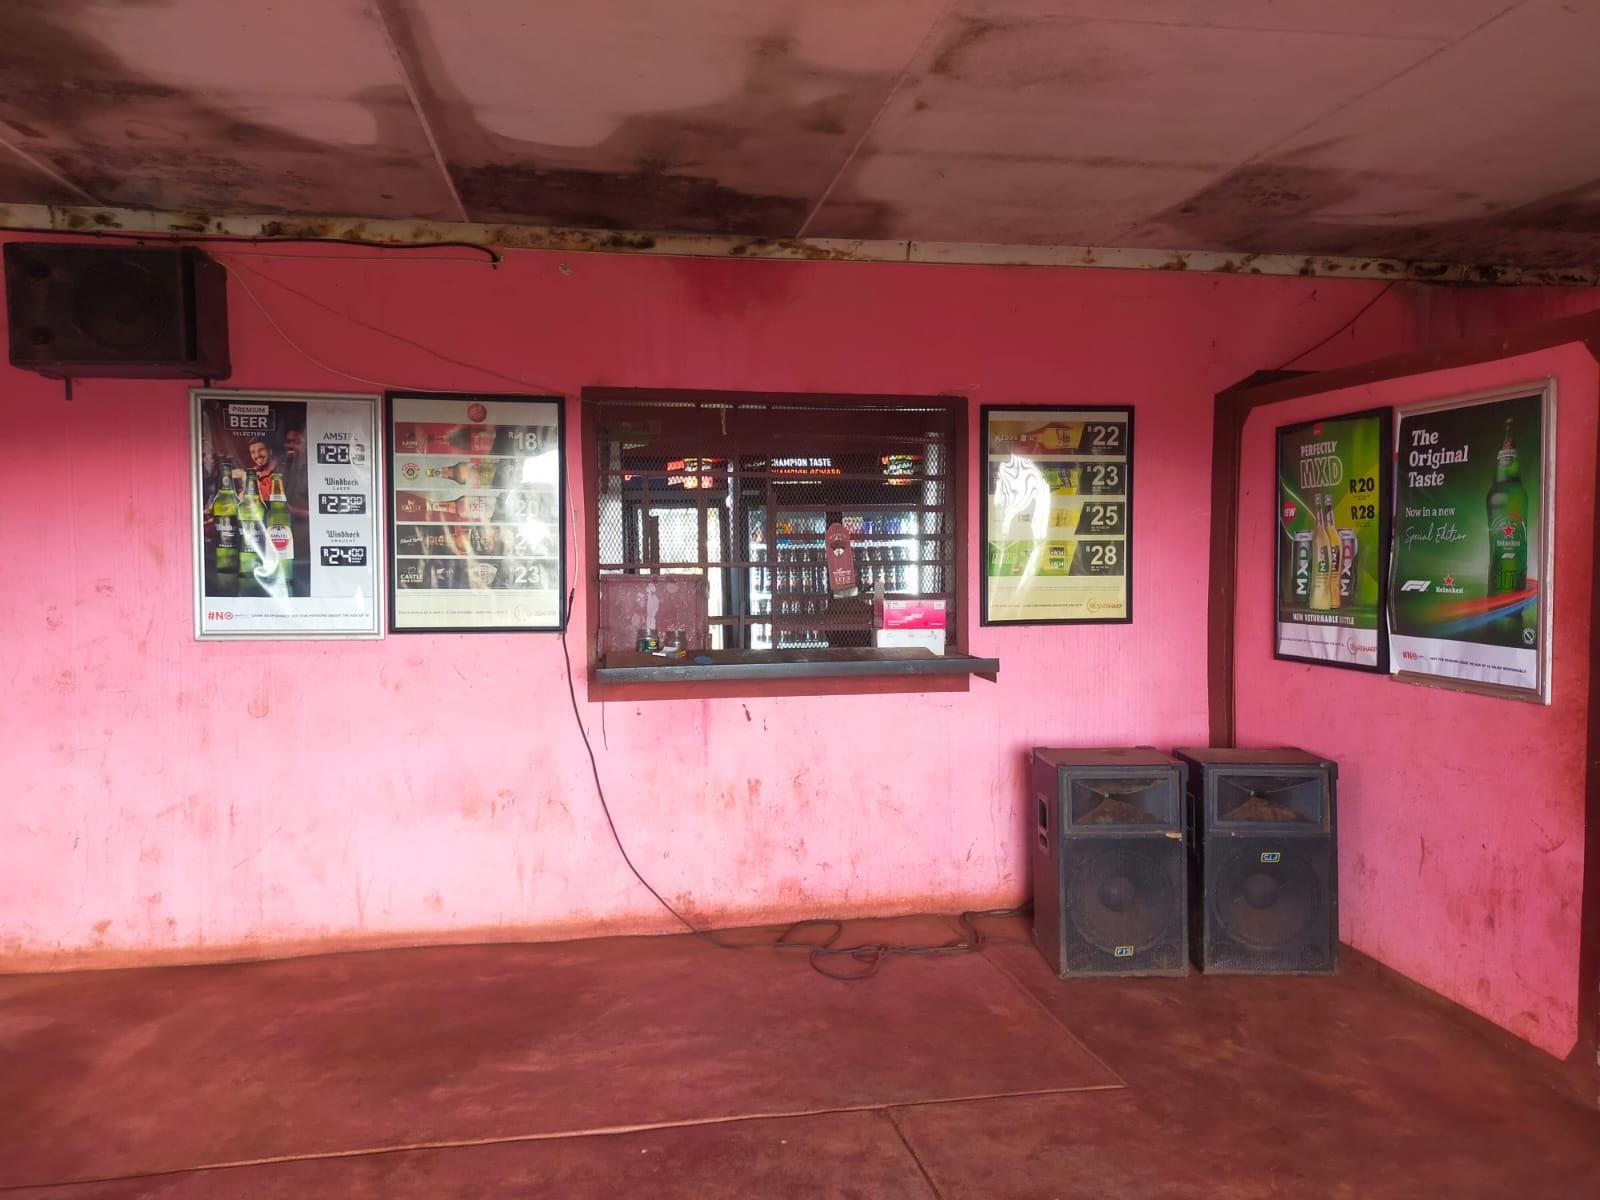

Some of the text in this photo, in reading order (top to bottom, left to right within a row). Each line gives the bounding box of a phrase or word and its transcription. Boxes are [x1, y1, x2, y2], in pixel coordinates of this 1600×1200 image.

[231, 406, 267, 414] PREMIUM
[230, 415, 268, 428] BEER
[1411, 429, 1439, 446] The
[1300, 440, 1338, 457] PERFECTLY
[809, 458, 831, 467] TASTE
[1409, 445, 1469, 469] Original
[1300, 455, 1344, 489] MXD
[1408, 471, 1445, 487] Taste
[1350, 477, 1375, 493] R20
[1351, 504, 1375, 520] R28
[1405, 506, 1456, 518] Now in a new
[1296, 546, 1309, 595] MXD
[1340, 543, 1354, 596] MXD
[1304, 613, 1338, 624] RETURNABLE
